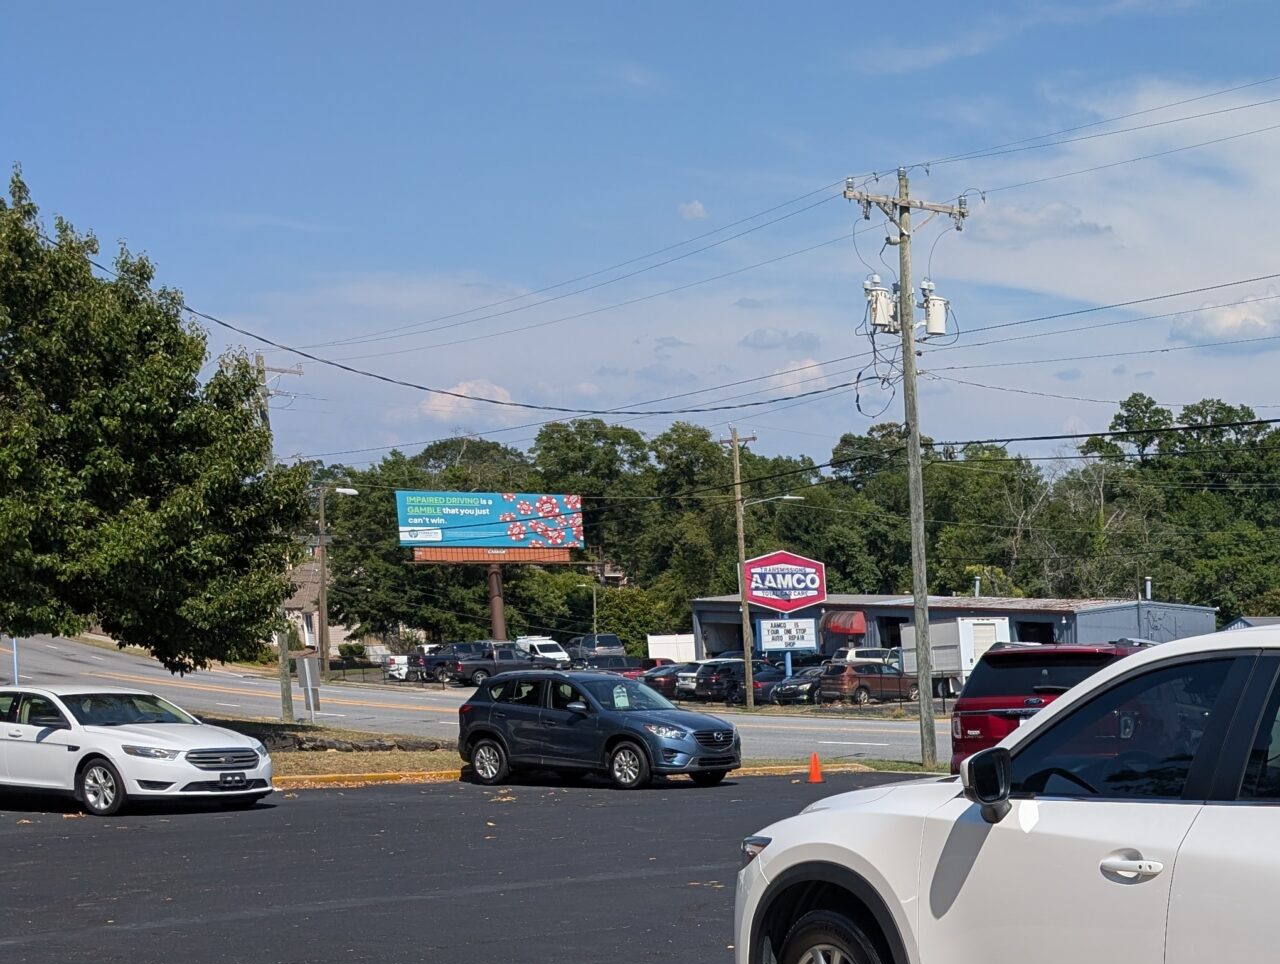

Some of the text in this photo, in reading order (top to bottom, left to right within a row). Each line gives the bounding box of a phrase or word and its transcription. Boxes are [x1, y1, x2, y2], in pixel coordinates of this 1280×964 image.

[406, 496, 444, 504] IMPAIRED
[408, 506, 442, 514] GAMBLE
[475, 508, 490, 516] just
[751, 574, 820, 588] AAMCO
